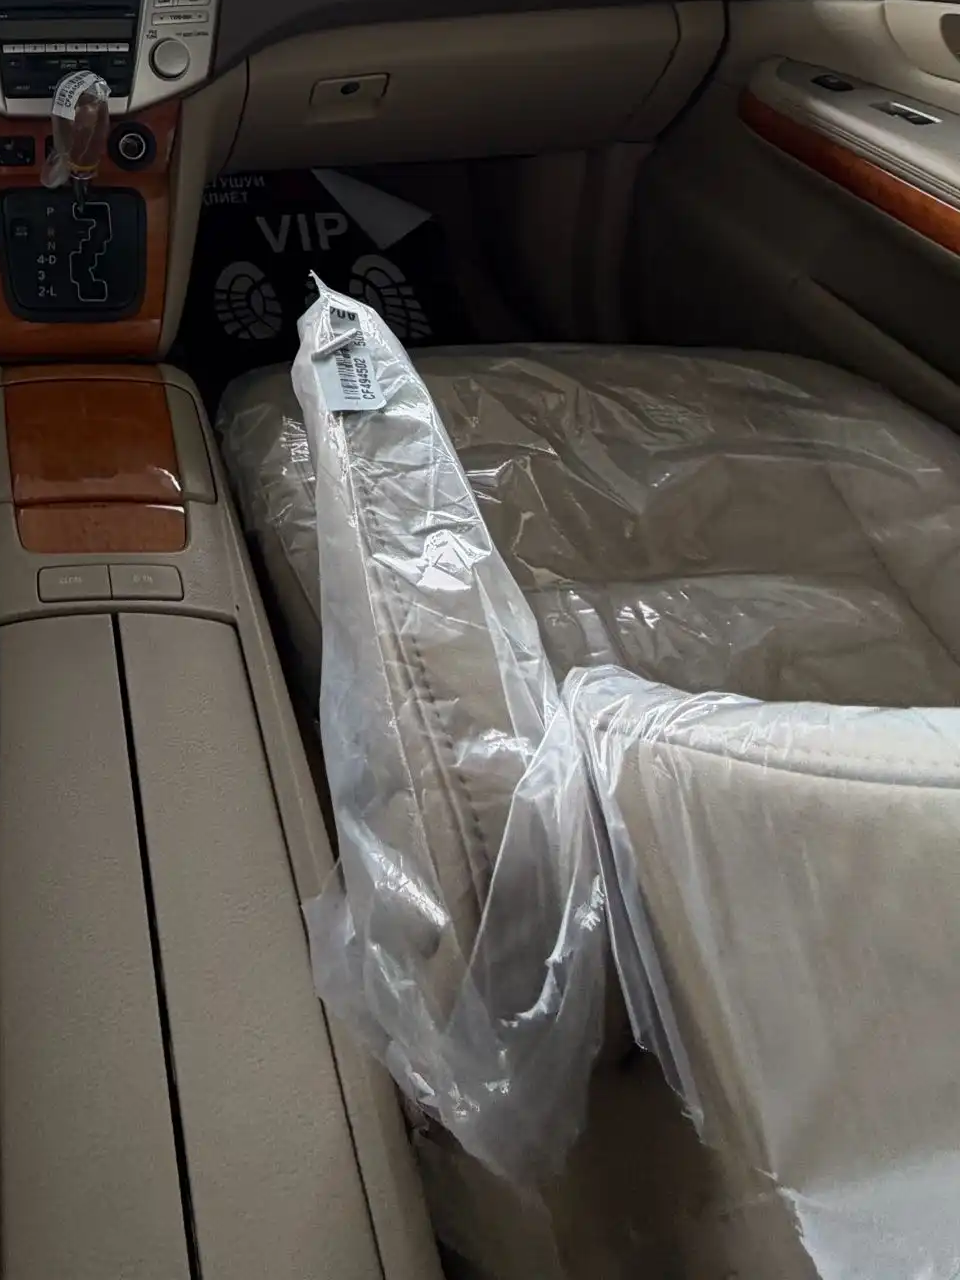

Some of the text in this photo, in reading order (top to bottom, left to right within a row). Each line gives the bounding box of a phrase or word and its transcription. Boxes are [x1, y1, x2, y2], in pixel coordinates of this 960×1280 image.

[46, 207, 55, 216] P
[255, 211, 349, 254] VIP
[47, 241, 56, 250] N
[37, 270, 46, 281] 3
[354, 357, 376, 400] CF494502
